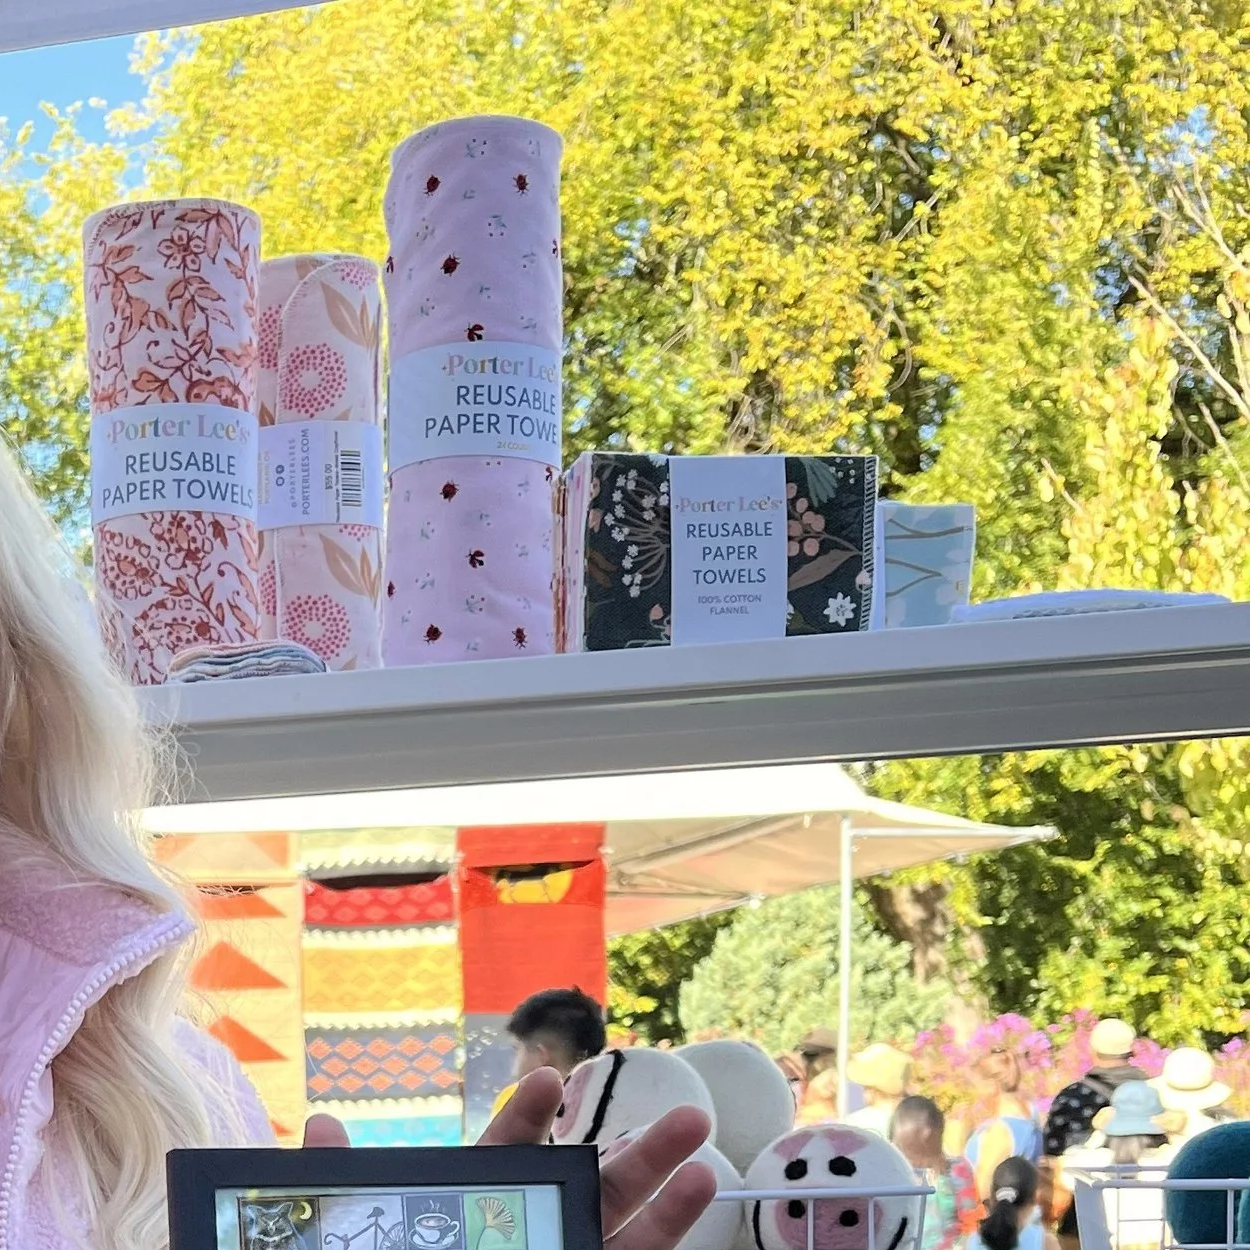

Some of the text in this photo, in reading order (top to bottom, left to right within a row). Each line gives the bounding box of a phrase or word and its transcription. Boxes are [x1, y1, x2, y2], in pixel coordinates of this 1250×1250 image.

[445, 353, 557, 383] Porter Lee'
[456, 385, 556, 416] REUSABLE
[111, 414, 249, 444] Porter Lee's
[425, 413, 557, 444] PAPER TOWE
[125, 451, 236, 476] REUSABLE
[301, 428, 310, 516] PORTERLEES.COM
[102, 478, 253, 509] PAPER TOWELS
[679, 496, 780, 513] Porter Lee's
[686, 521, 773, 538] REUSABLE
[702, 545, 758, 561] PAPER
[692, 568, 767, 585] TOWELS
[709, 606, 750, 616] FLANNEL
[723, 594, 762, 604] COTTON
